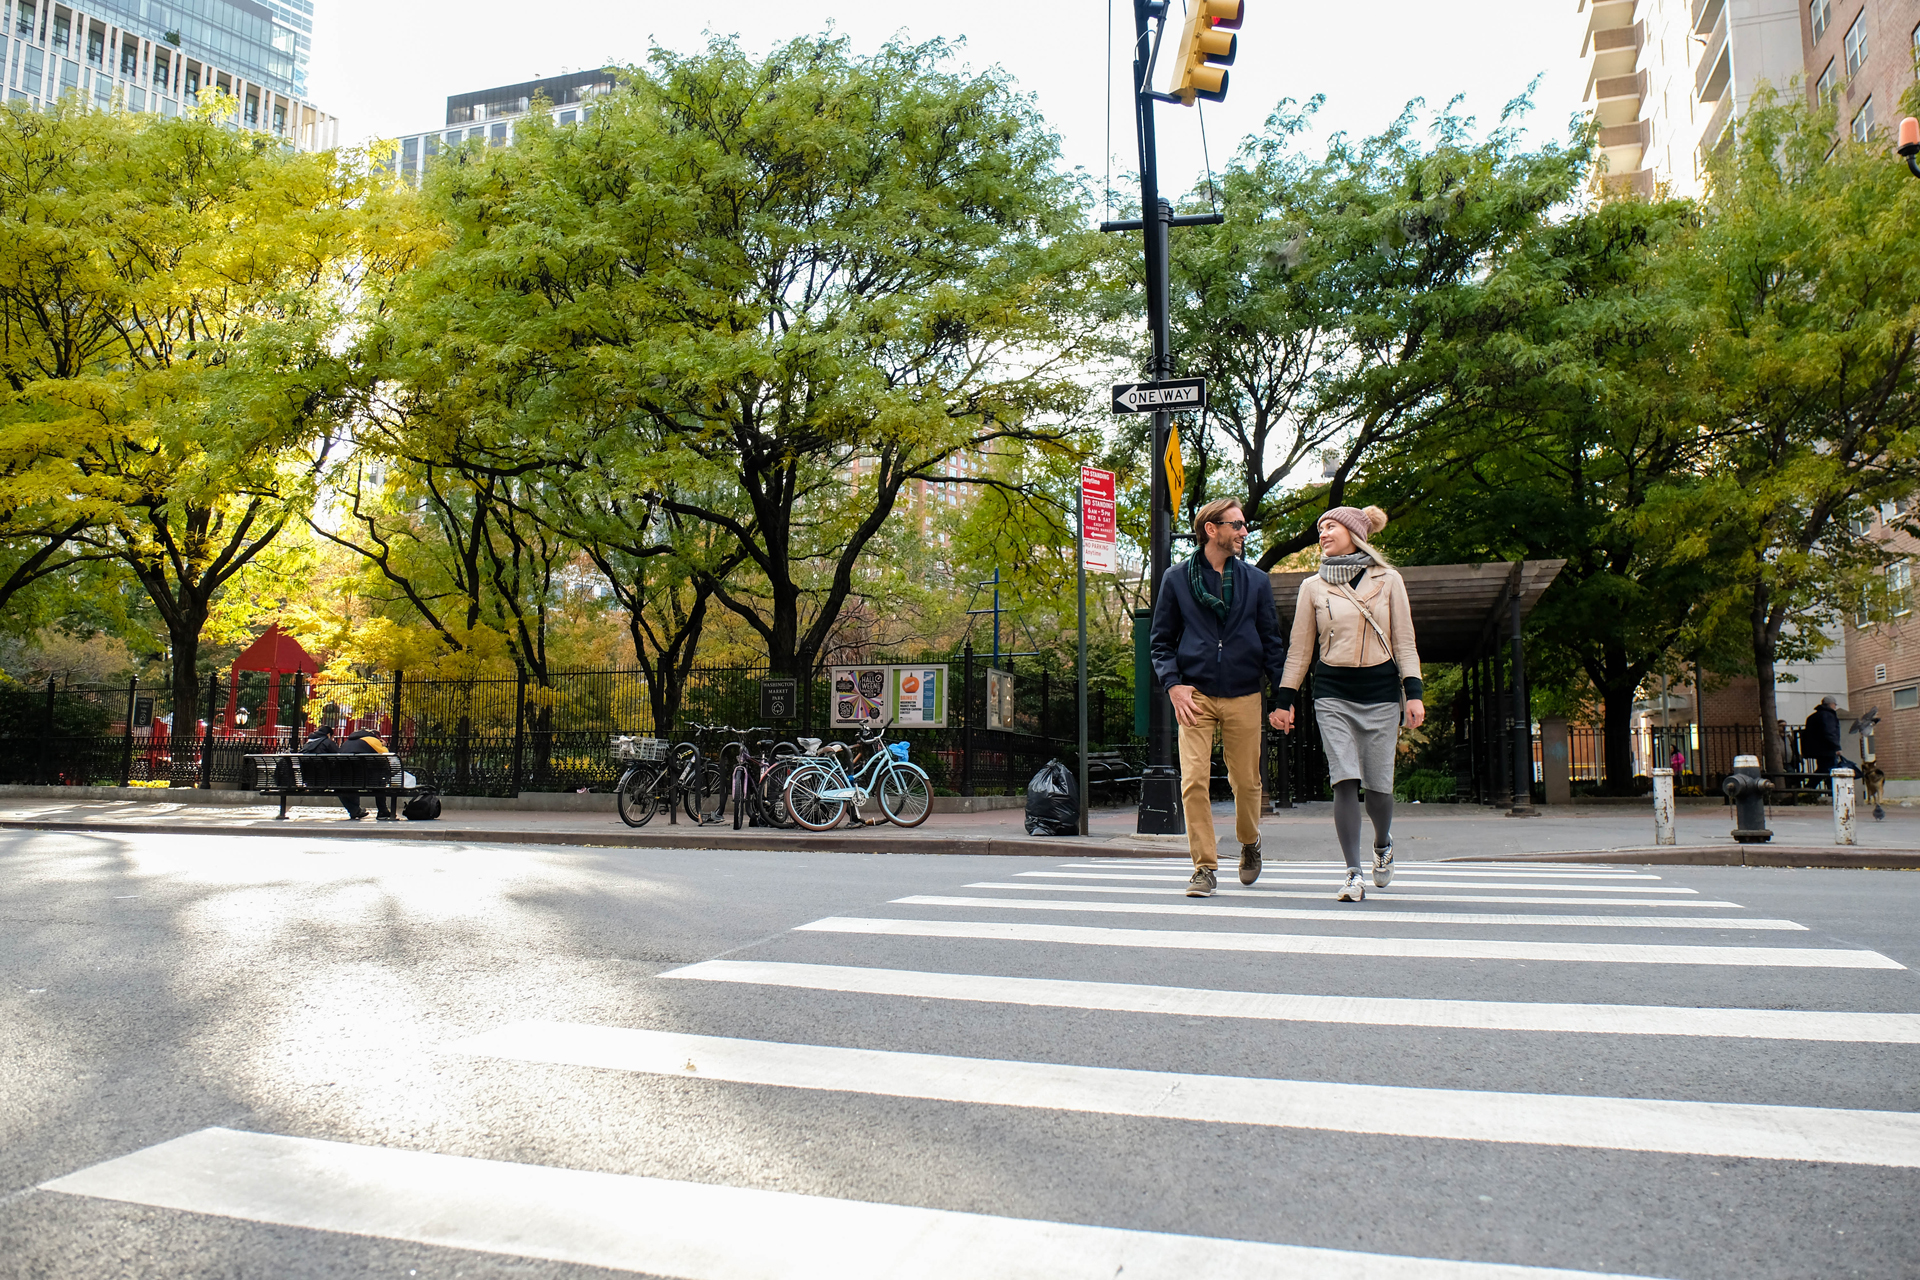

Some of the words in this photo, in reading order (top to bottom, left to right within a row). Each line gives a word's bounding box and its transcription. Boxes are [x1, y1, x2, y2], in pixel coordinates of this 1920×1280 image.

[1129, 391, 1156, 404] ONE
[1164, 389, 1192, 401] WAY
[1090, 471, 1109, 480] STANDING
[1084, 476, 1100, 485] Anytime
[1092, 500, 1113, 509] STANDING
[1092, 543, 1108, 551] PARKING
